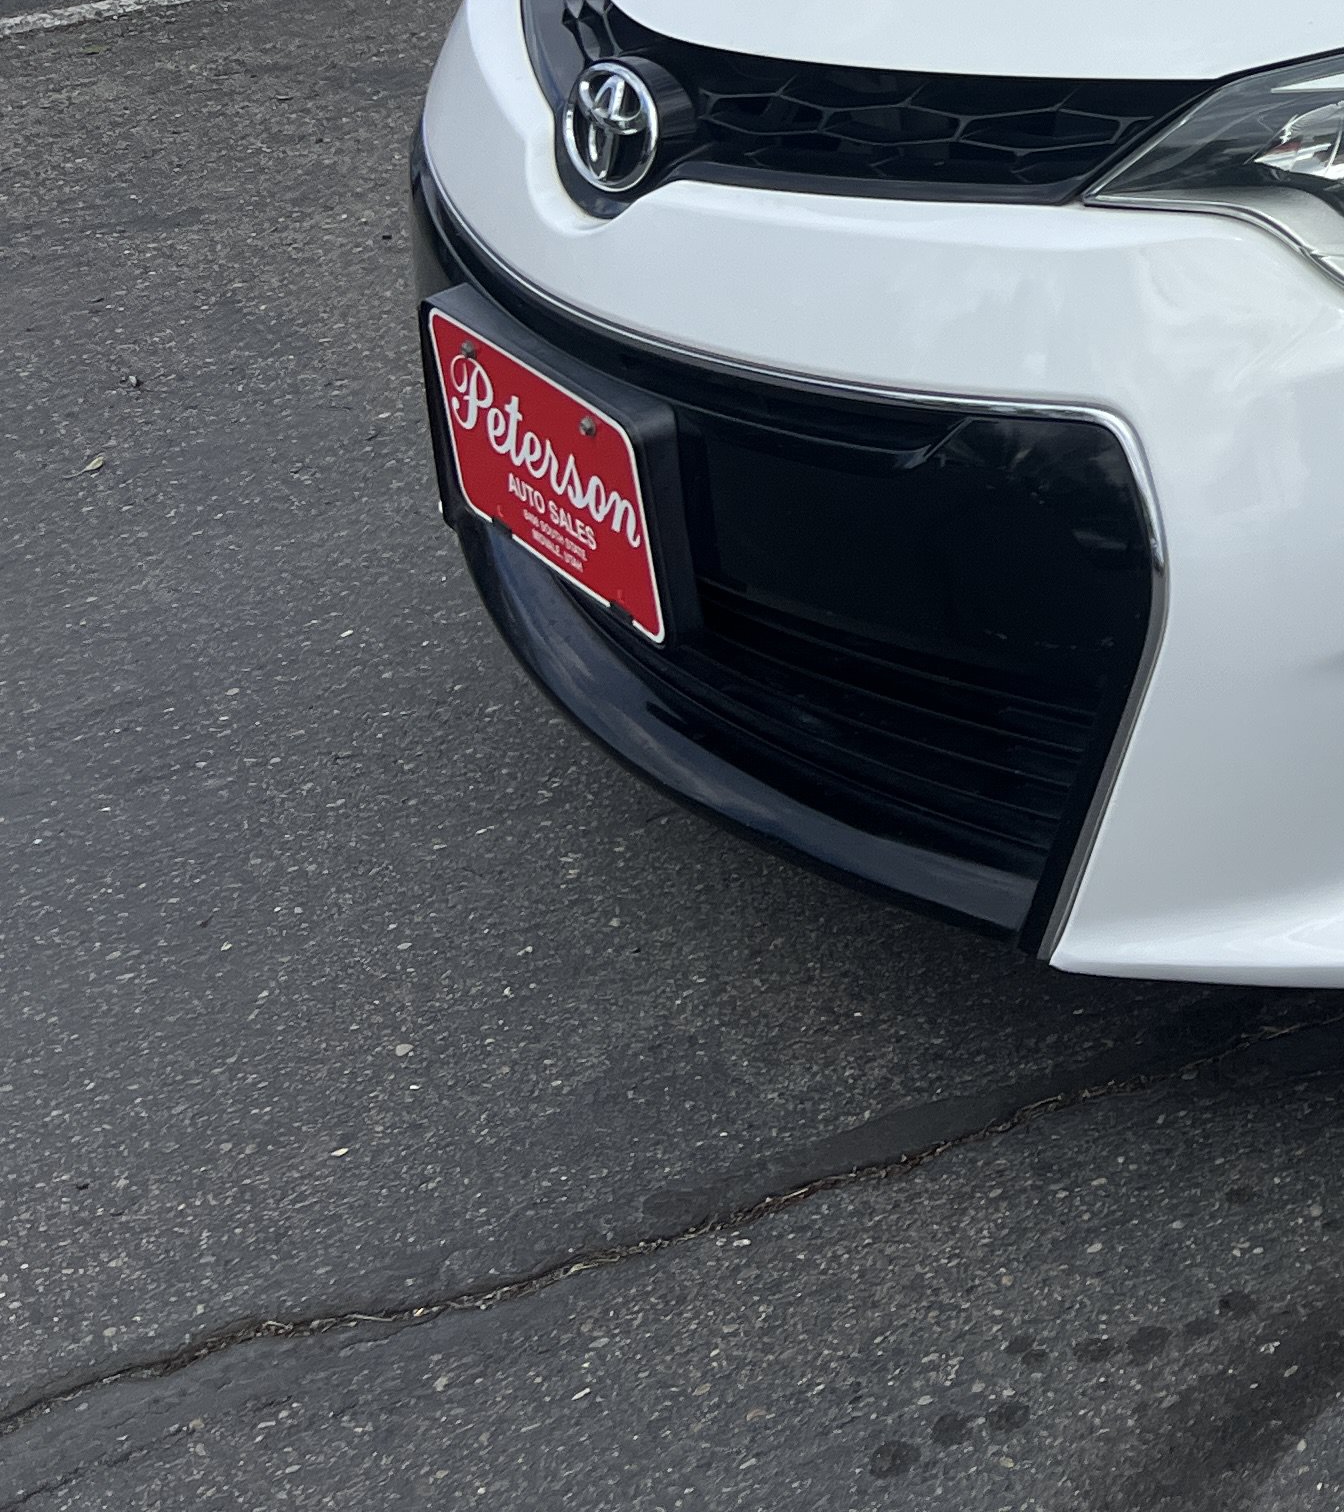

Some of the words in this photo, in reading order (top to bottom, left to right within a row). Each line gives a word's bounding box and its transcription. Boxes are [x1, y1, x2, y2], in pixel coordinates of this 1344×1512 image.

[450, 353, 641, 548] Peterson
[508, 472, 545, 514] AUTO
[548, 500, 597, 551] SALES
